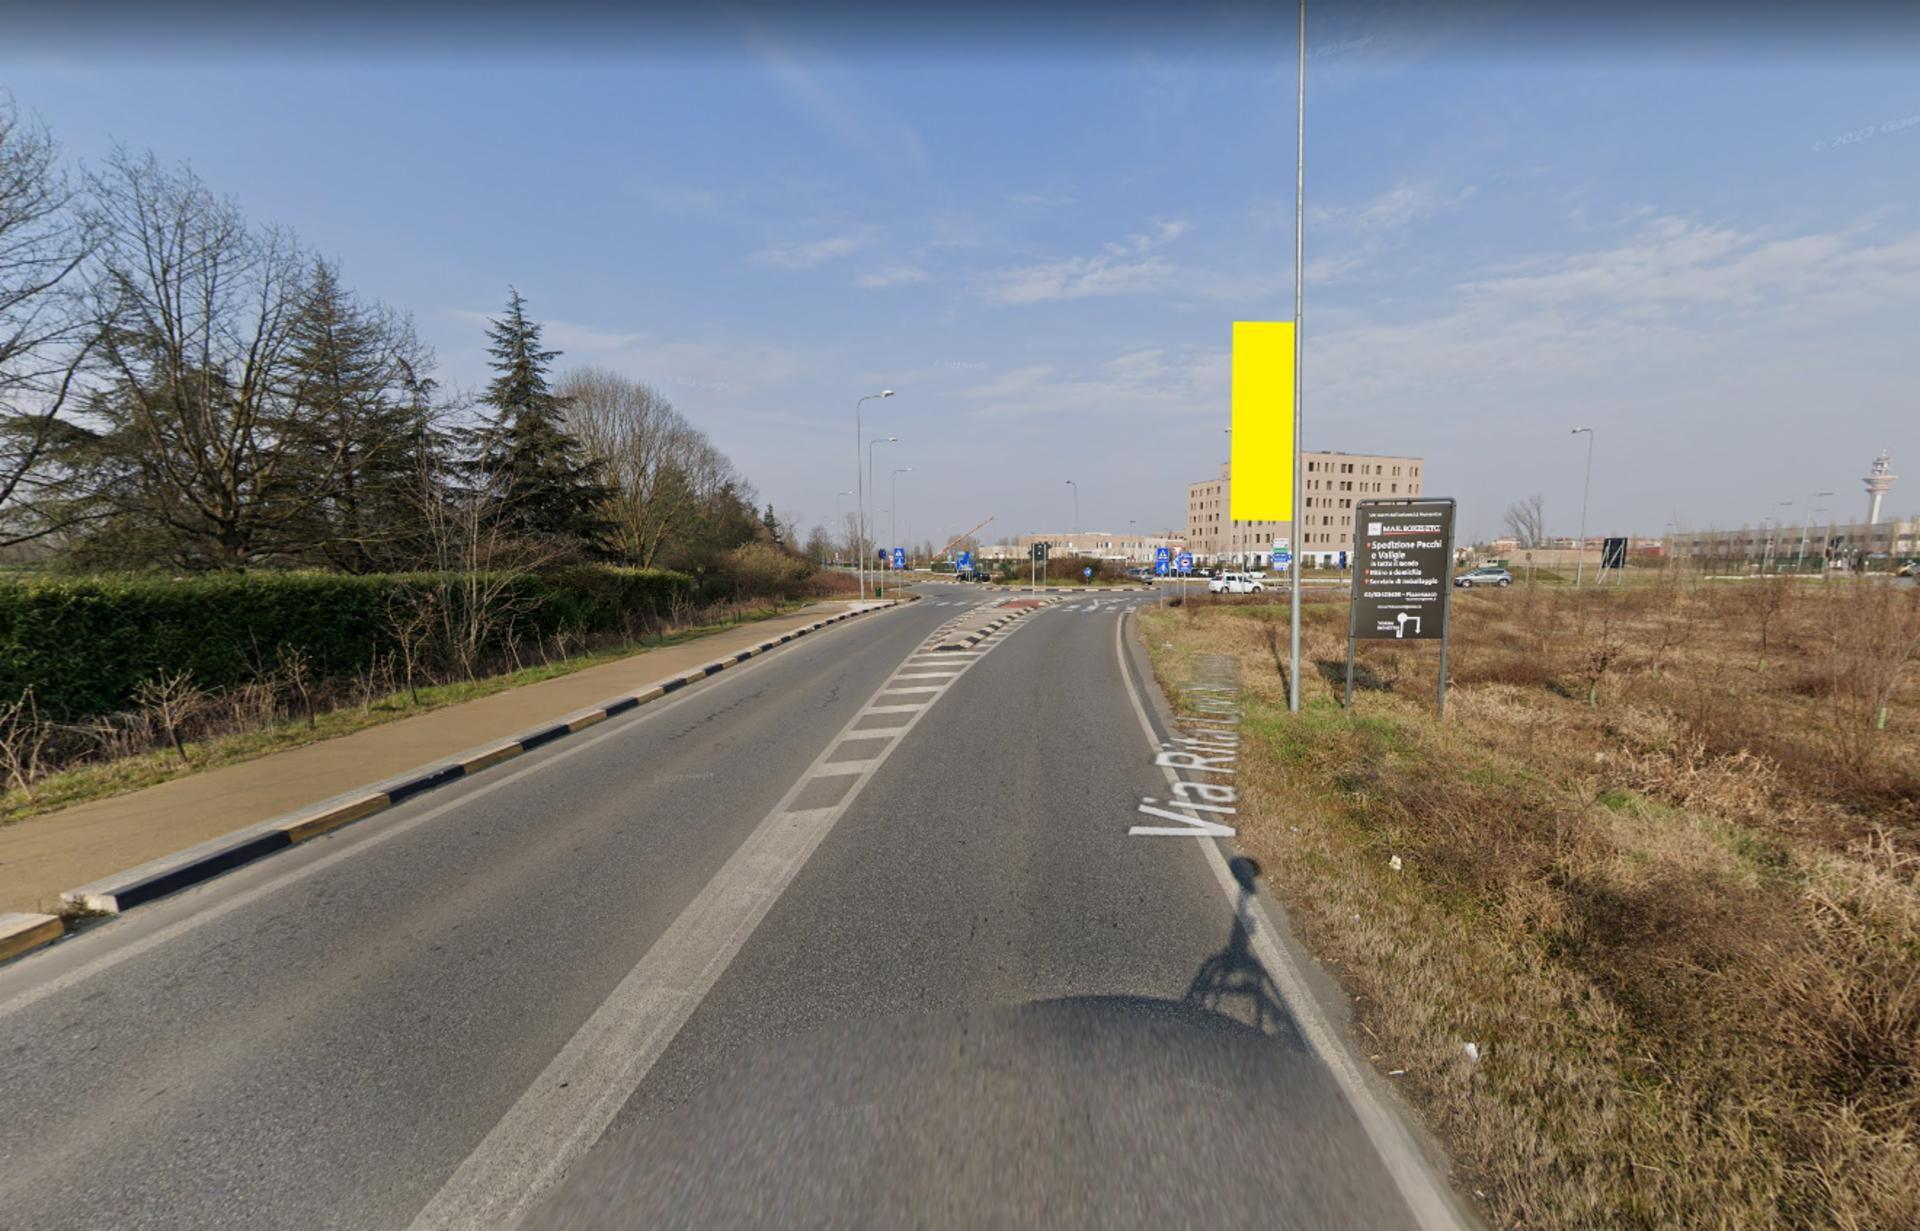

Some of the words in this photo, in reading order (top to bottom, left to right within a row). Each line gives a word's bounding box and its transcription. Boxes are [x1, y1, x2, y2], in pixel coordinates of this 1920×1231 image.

[1371, 541, 1415, 550] Spedizione
[1416, 539, 1442, 549] Pacchi
[1378, 550, 1406, 561] Valigie
